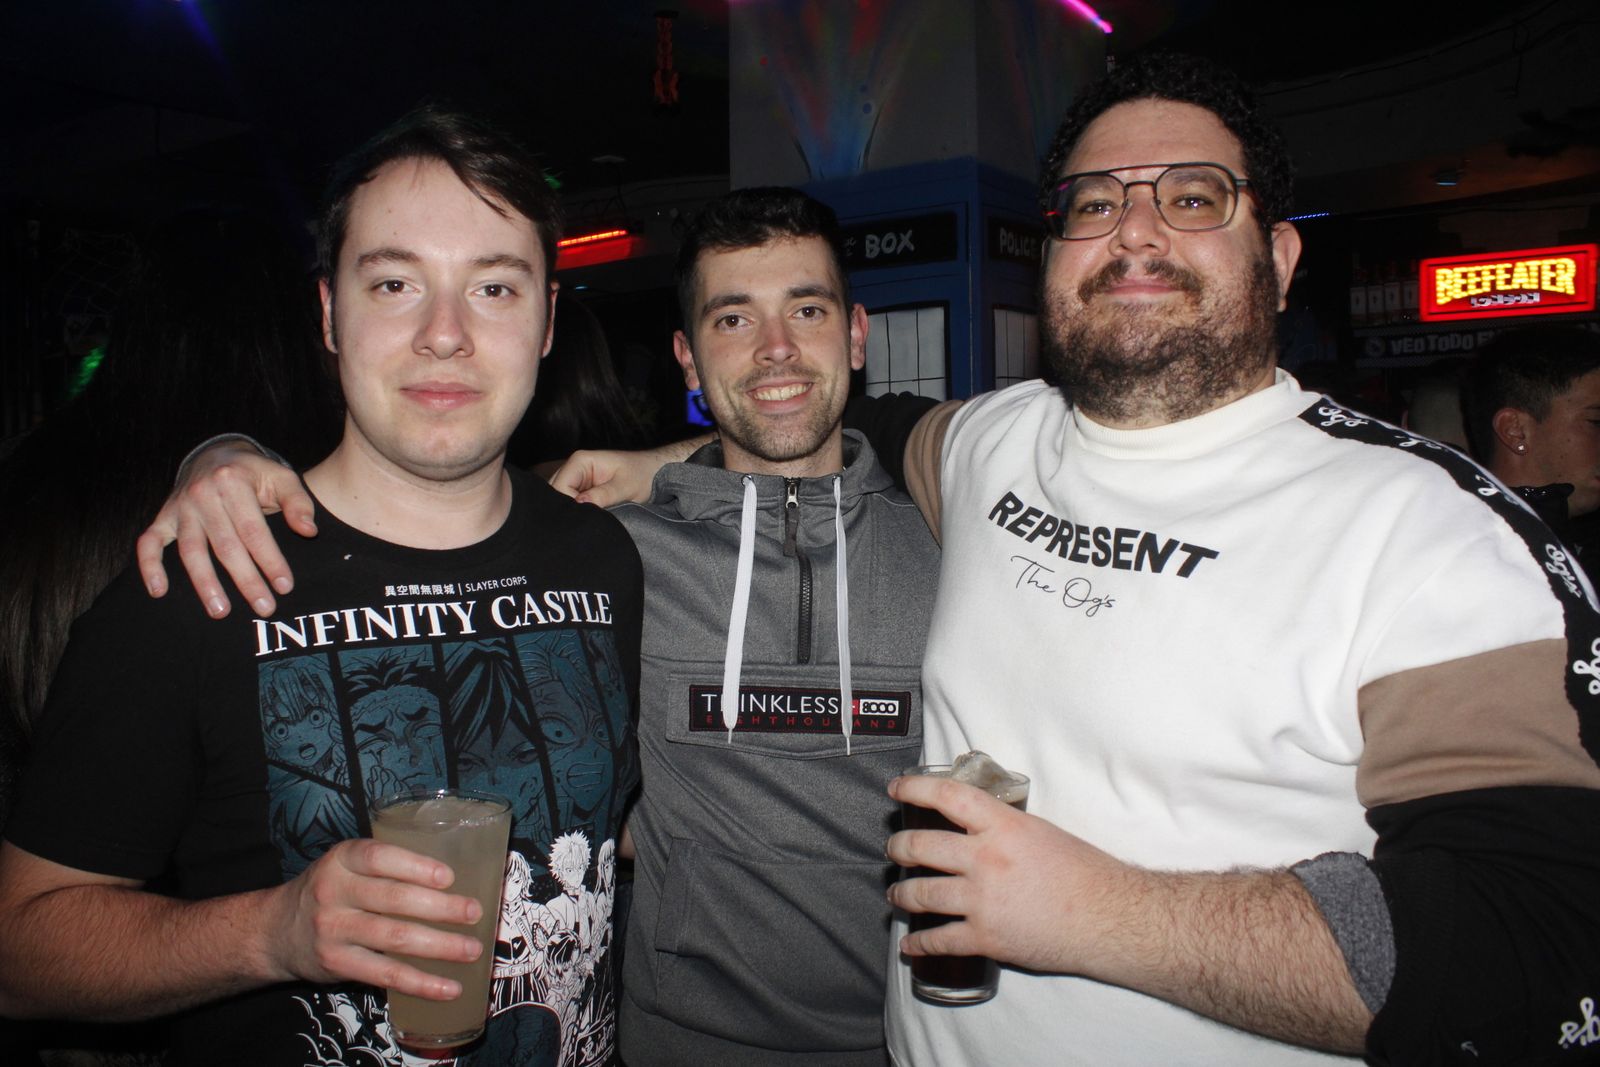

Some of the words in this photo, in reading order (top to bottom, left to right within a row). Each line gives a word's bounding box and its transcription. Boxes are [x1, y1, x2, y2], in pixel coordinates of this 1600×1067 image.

[864, 229, 915, 259] BOX
[1435, 258, 1577, 305] BEEFEATER
[988, 491, 1220, 578] REPRESENT
[465, 579, 500, 593] SLAYER
[500, 575, 528, 588] CORPS
[1010, 555, 1056, 593] The
[252, 600, 477, 656] INFINITY
[491, 590, 613, 629] CASTLE
[701, 693, 839, 715] TINKLESS
